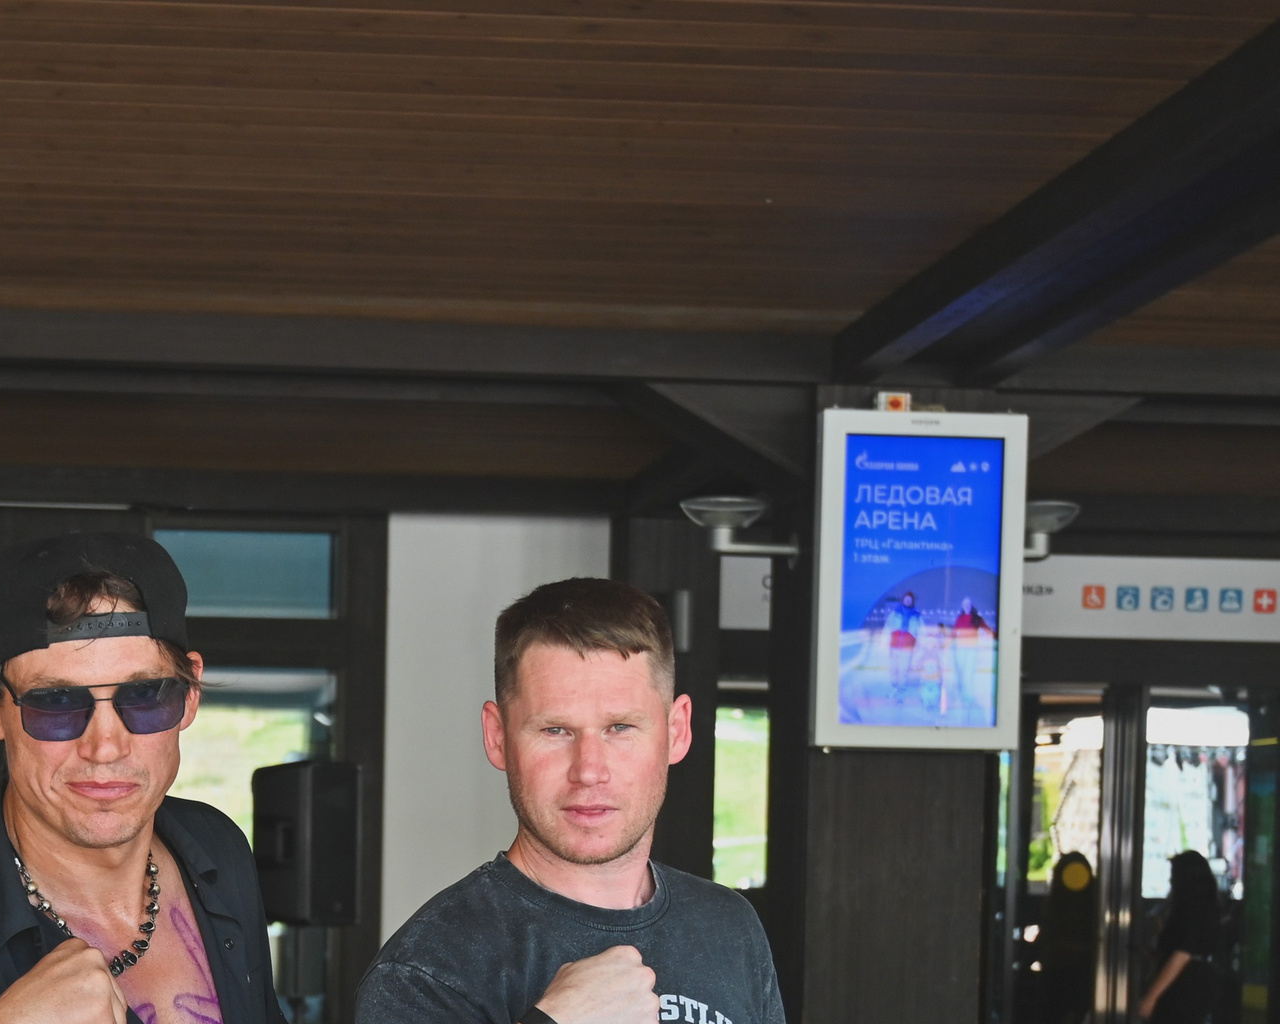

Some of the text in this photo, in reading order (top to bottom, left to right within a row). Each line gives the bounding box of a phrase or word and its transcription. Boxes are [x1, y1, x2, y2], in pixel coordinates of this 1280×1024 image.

[854, 484, 973, 507] ЛЕДОВАЯ
[854, 510, 938, 530] АРЕНА
[855, 538, 878, 551] ТРЦ
